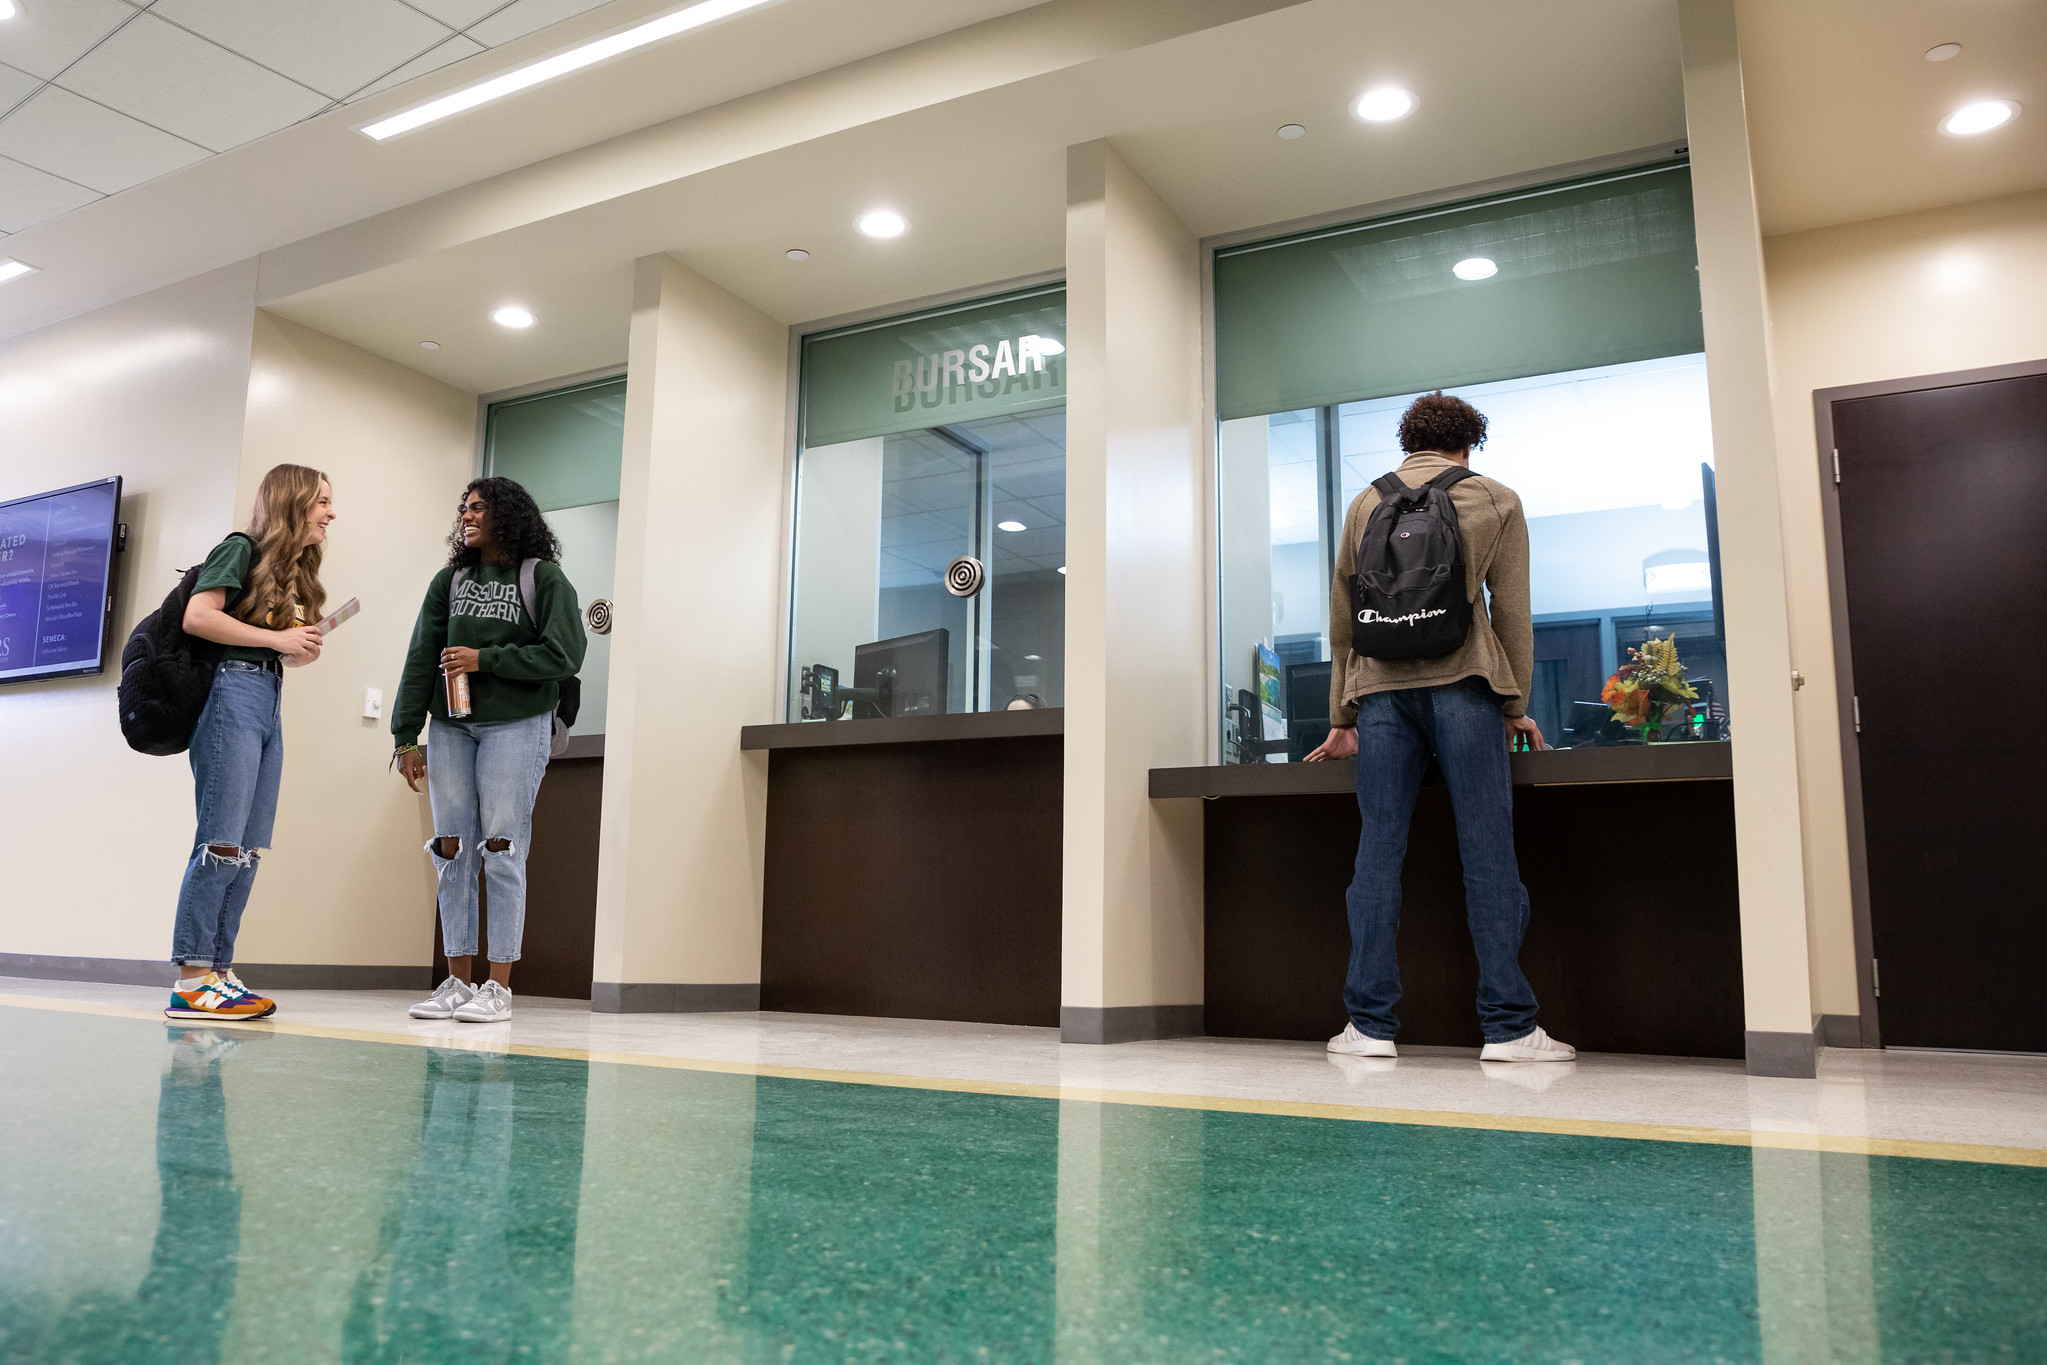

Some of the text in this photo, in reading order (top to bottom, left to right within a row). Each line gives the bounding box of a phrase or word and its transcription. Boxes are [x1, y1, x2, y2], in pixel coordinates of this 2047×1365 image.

[893, 335, 1043, 396] BURSAR
[0, 549, 14, 562] R?
[452, 580, 521, 606] MISSOUR
[449, 600, 521, 625] OUTHERN
[1357, 608, 1447, 627] Champion
